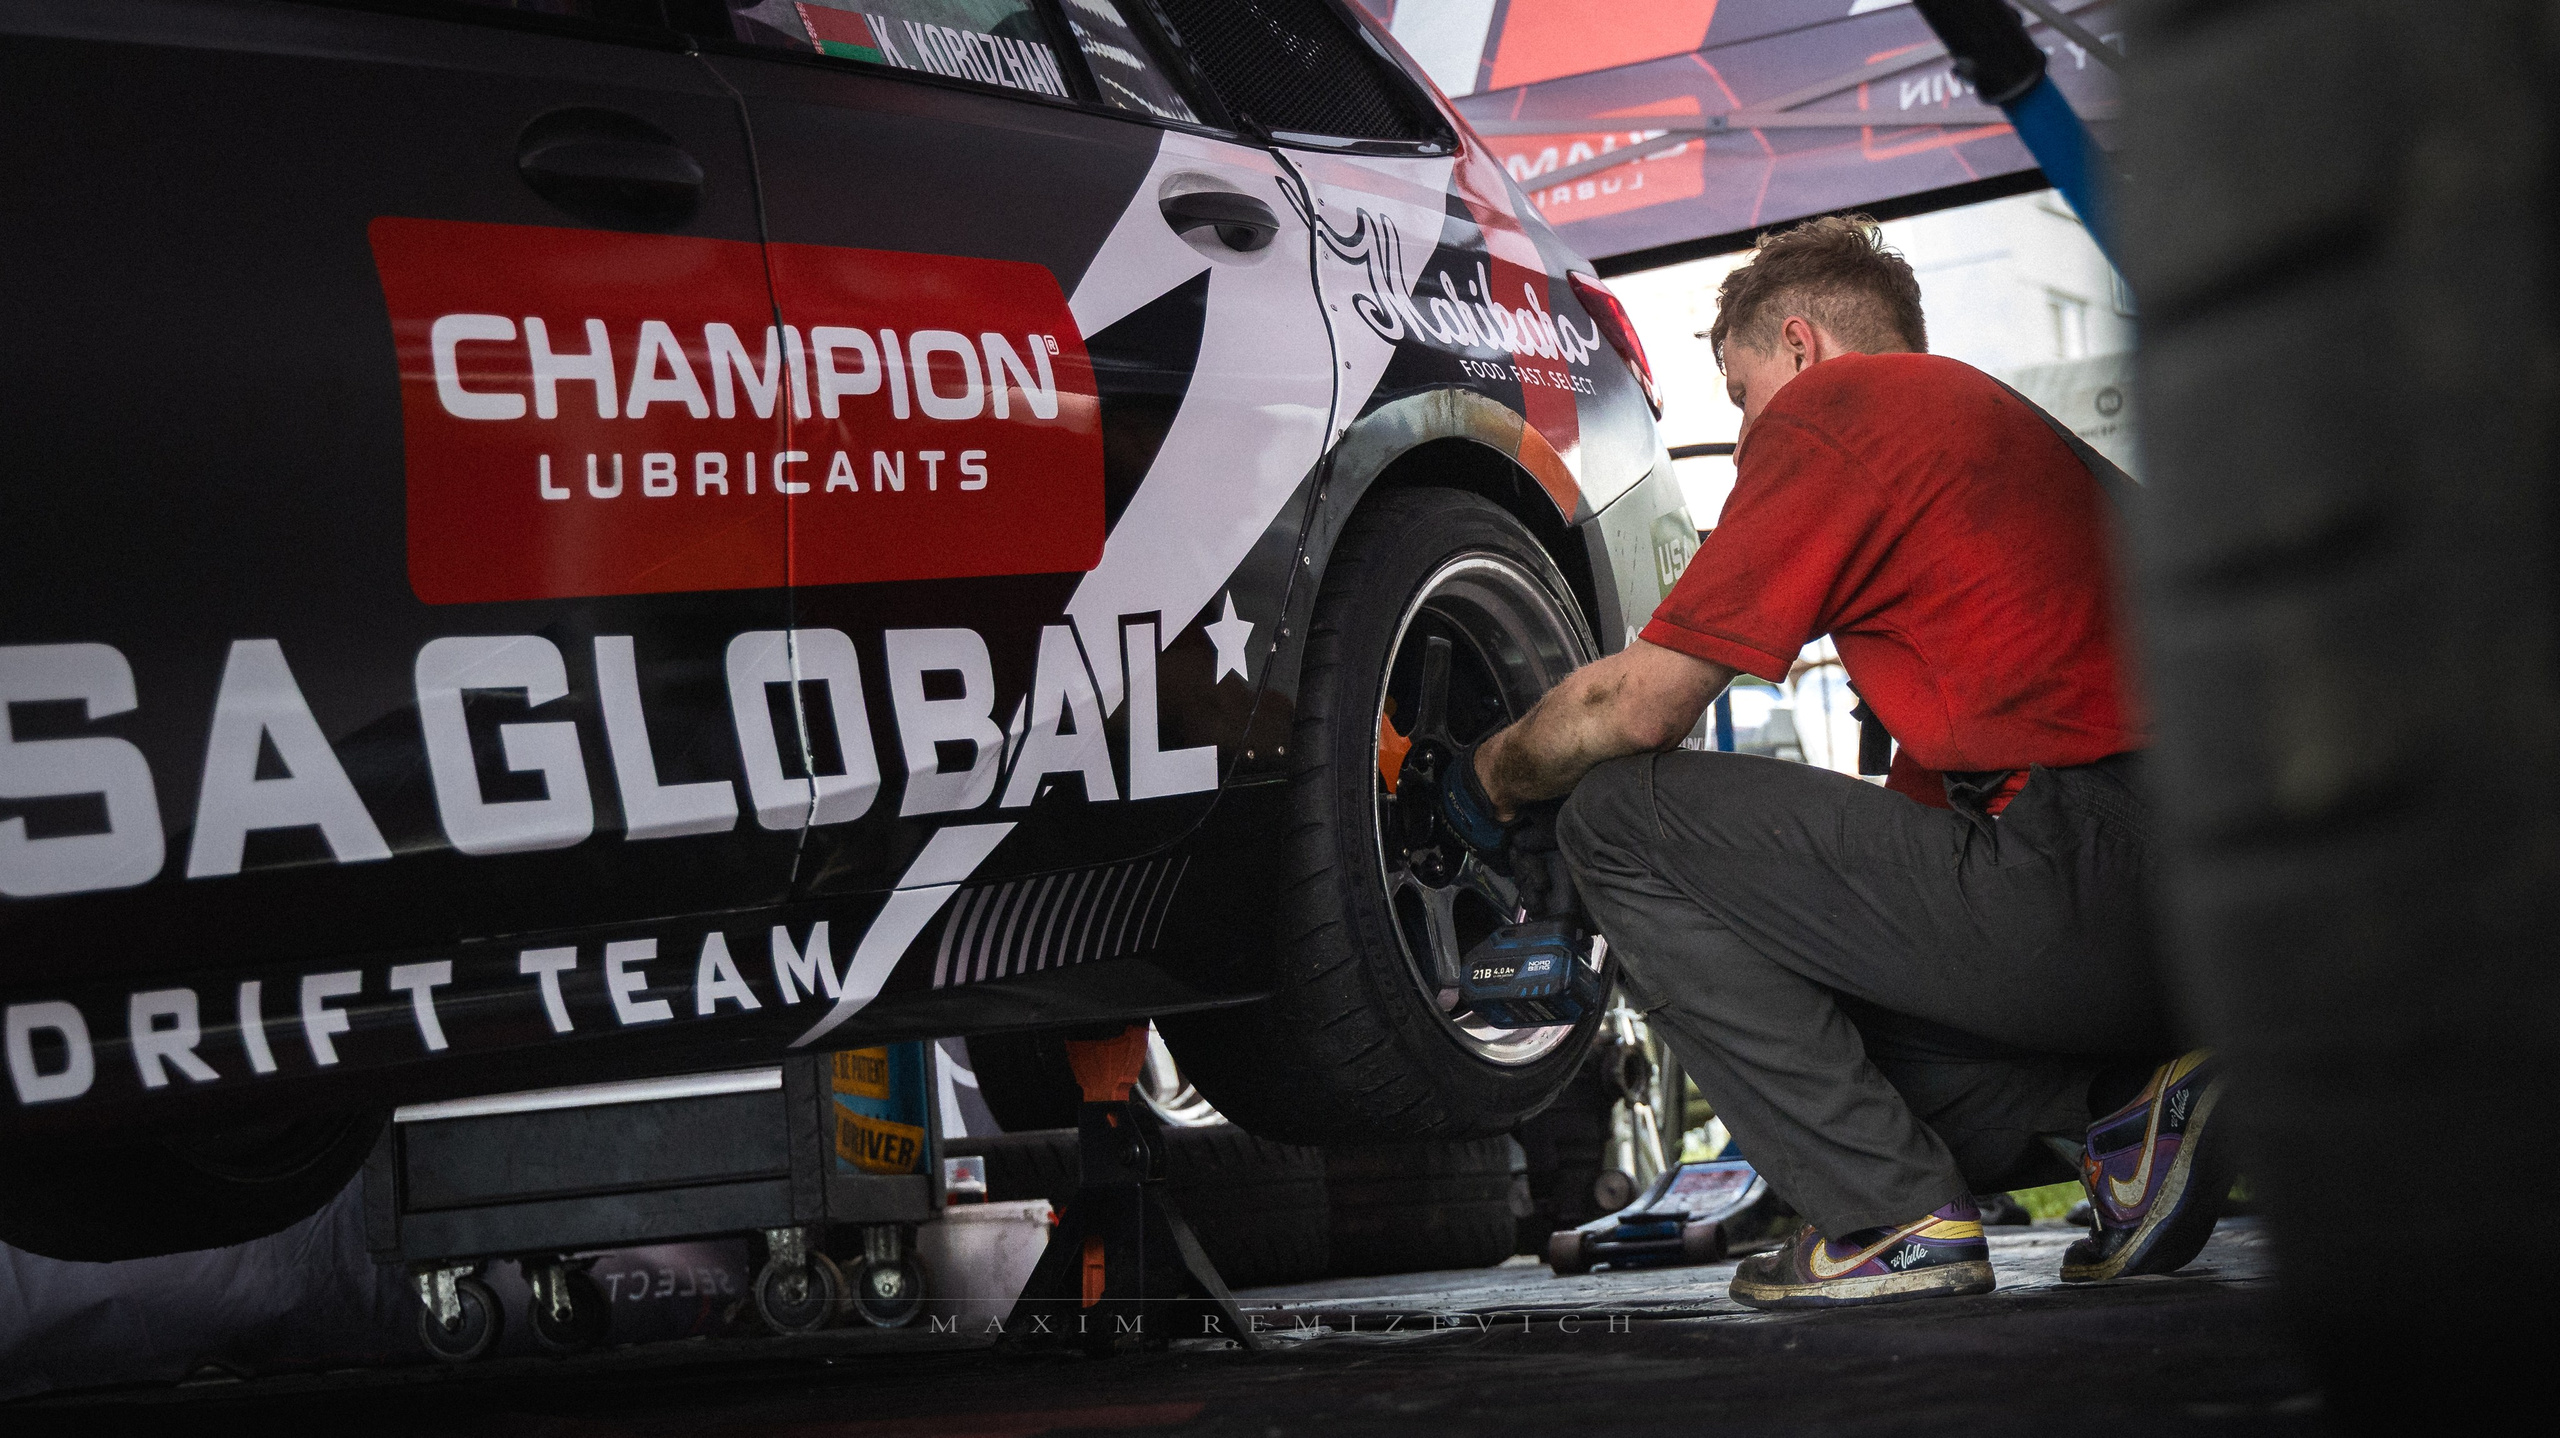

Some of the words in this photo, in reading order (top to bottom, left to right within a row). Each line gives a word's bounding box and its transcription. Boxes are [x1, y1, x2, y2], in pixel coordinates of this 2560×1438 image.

[866, 13, 917, 71] K.
[902, 20, 1069, 98] KOROZHAN
[430, 313, 1060, 420] CHAMPION
[1548, 371, 1597, 395] SELECT
[540, 450, 988, 500] LUBRICANTS
[414, 621, 1219, 856] GLOBAL
[5, 959, 452, 1105] DRIFT
[519, 920, 843, 1033] TEAM
[842, 1117, 916, 1165] DRIVER
